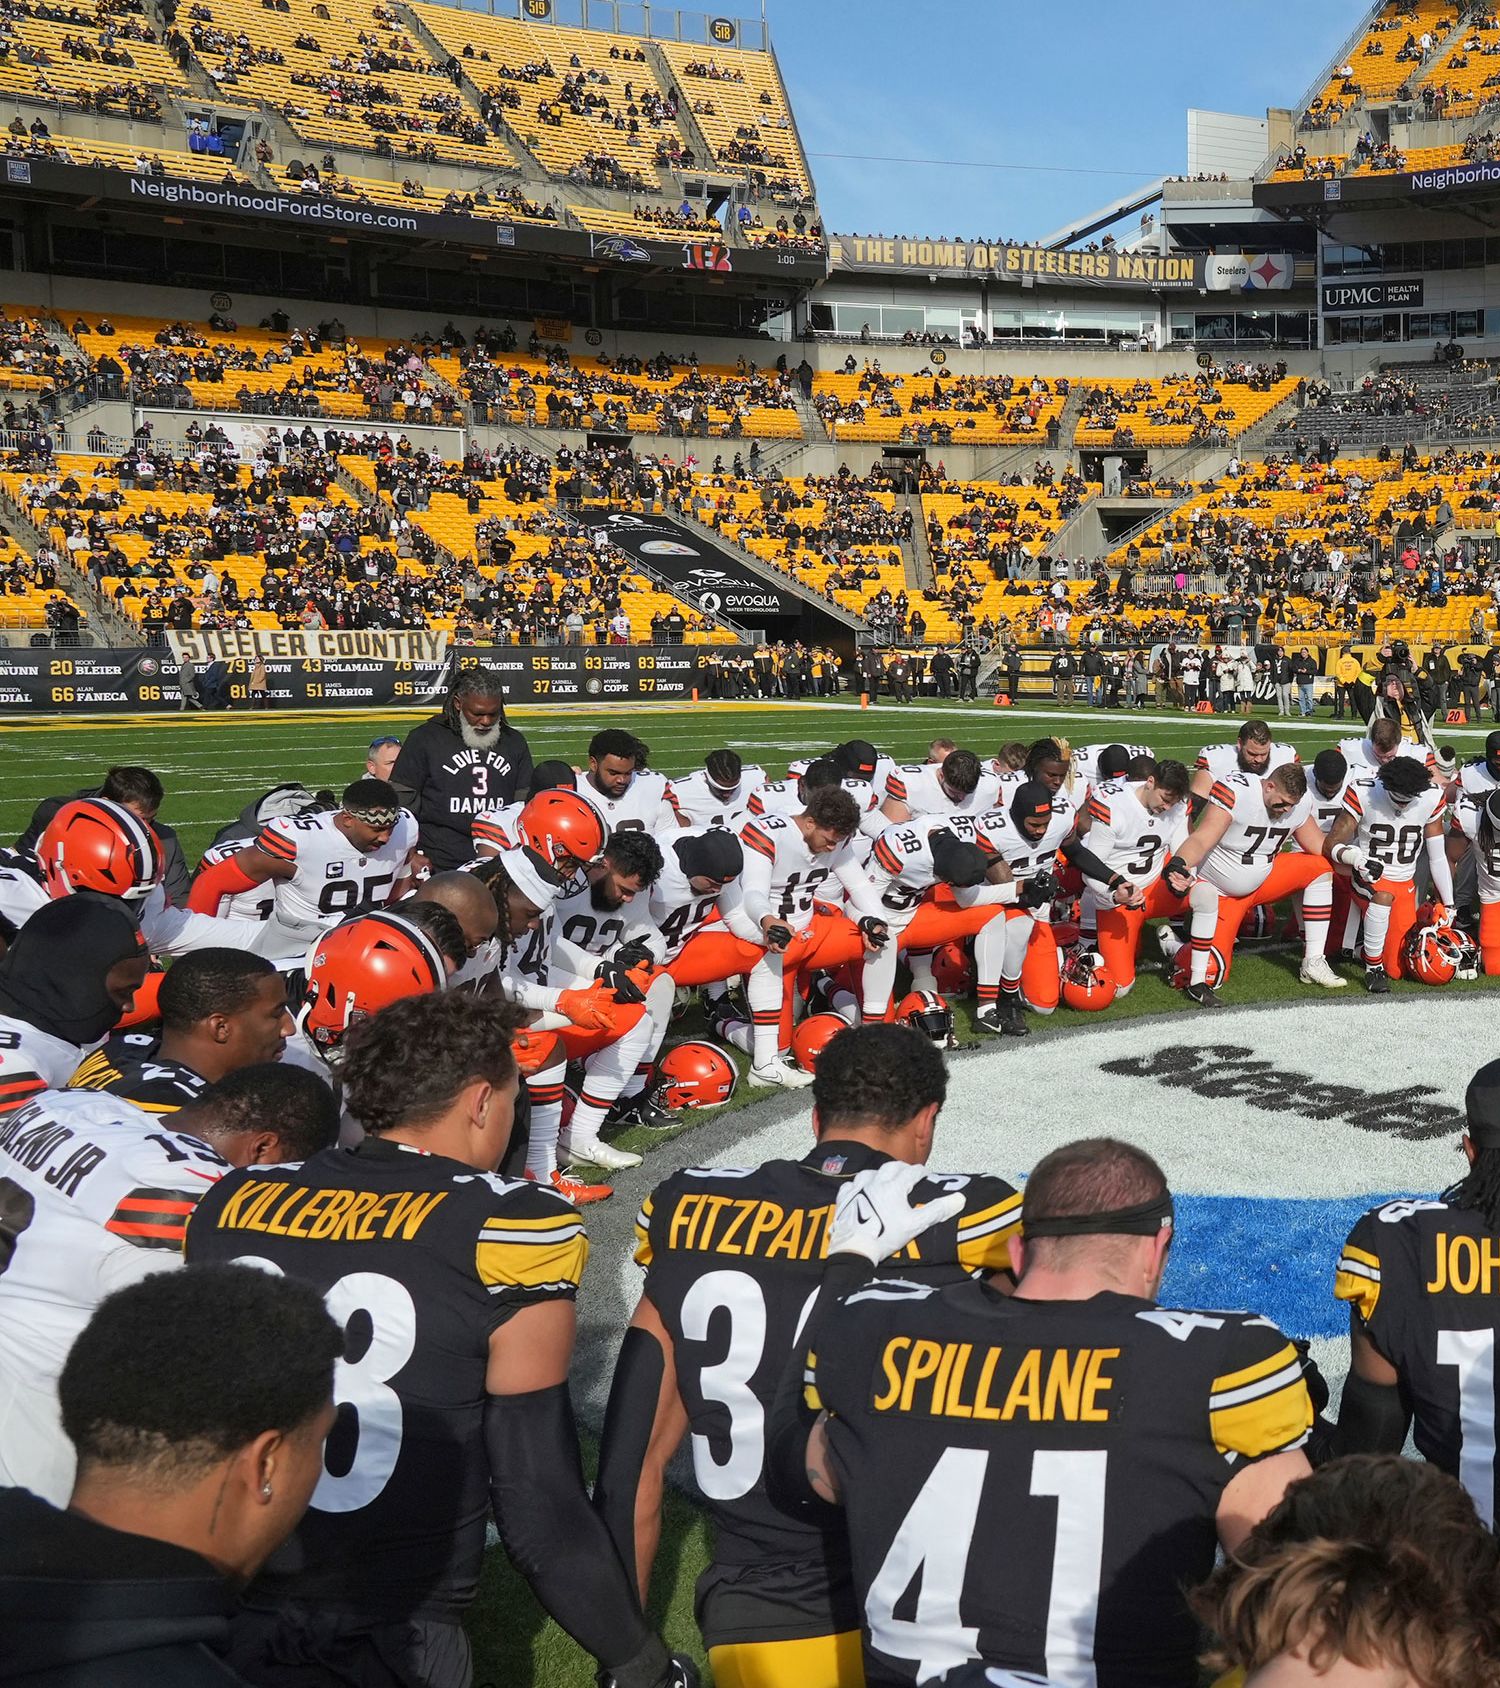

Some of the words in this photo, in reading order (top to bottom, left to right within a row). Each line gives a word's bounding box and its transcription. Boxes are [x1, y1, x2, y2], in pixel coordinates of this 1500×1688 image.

[529, 1, 545, 15] 519
[715, 26, 731, 40] 518
[131, 178, 417, 231] NeighborhoodFordStore.com
[777, 254, 795, 265] 1:00
[853, 239, 894, 263] THE
[903, 243, 966, 267] HOME
[974, 245, 1000, 268] OF
[1006, 249, 1110, 278] STEELERS
[1117, 256, 1194, 280] NATION
[1217, 265, 1247, 276] Steelers
[1325, 287, 1381, 306] UPMC
[1388, 285, 1419, 294] HEALTH
[1388, 294, 1410, 302] PLAN
[932, 352, 945, 363] 218
[256, 462, 266, 470] 24
[302, 517, 313, 525] 24
[321, 514, 332, 523] 30
[601, 555, 609, 563] 99
[489, 591, 499, 600] 43
[619, 620, 626, 630] 5
[175, 630, 306, 660] STEELER
[318, 630, 443, 661] COUNTRY
[50, 660, 72, 675] 20
[226, 660, 246, 673] 79
[302, 660, 321, 672] 43
[324, 663, 383, 673] POLAMALU
[414, 662, 450, 671] WHITE
[480, 662, 523, 670] WAGNER
[532, 657, 549, 670] 55
[551, 662, 577, 670] KOLB
[585, 657, 601, 669] 83
[638, 657, 655, 669] 83
[656, 661, 691, 669] MILLER
[1058, 658, 1068, 667] 20
[0, 666, 38, 675] NUNN
[75, 665, 122, 675] BLEIER
[230, 684, 246, 699] 81
[306, 683, 323, 697] 51
[325, 687, 373, 697] FARRIOR
[394, 681, 412, 695] 95
[415, 686, 448, 695] LLOYD
[533, 680, 549, 693] 37
[552, 685, 578, 693] LAKE
[604, 684, 629, 692] COPE
[639, 679, 655, 692] 57
[656, 683, 684, 692] DAVIS
[0, 694, 32, 702] DIAL
[51, 687, 74, 702] 66
[77, 692, 128, 702] FANECA
[139, 686, 160, 700] 86
[1196, 701, 1209, 713] 10
[1448, 710, 1461, 723] 20
[442, 749, 481, 775] LOVE
[486, 751, 511, 776] FOR
[472, 766, 488, 795] 3
[450, 797, 504, 813] DAMAR
[981, 811, 1006, 831] 43
[895, 829, 923, 854] 38
[1242, 826, 1291, 866] 77
[1368, 823, 1422, 865] 20
[1127, 834, 1161, 875] 3
[318, 872, 393, 914] 95
[778, 867, 829, 922] 13
[44, 1142, 107, 1198] JR
[217, 1179, 449, 1241] KILLEBREW
[873, 1337, 1121, 1422] SPILLANE
[865, 1446, 1108, 1688] 41
